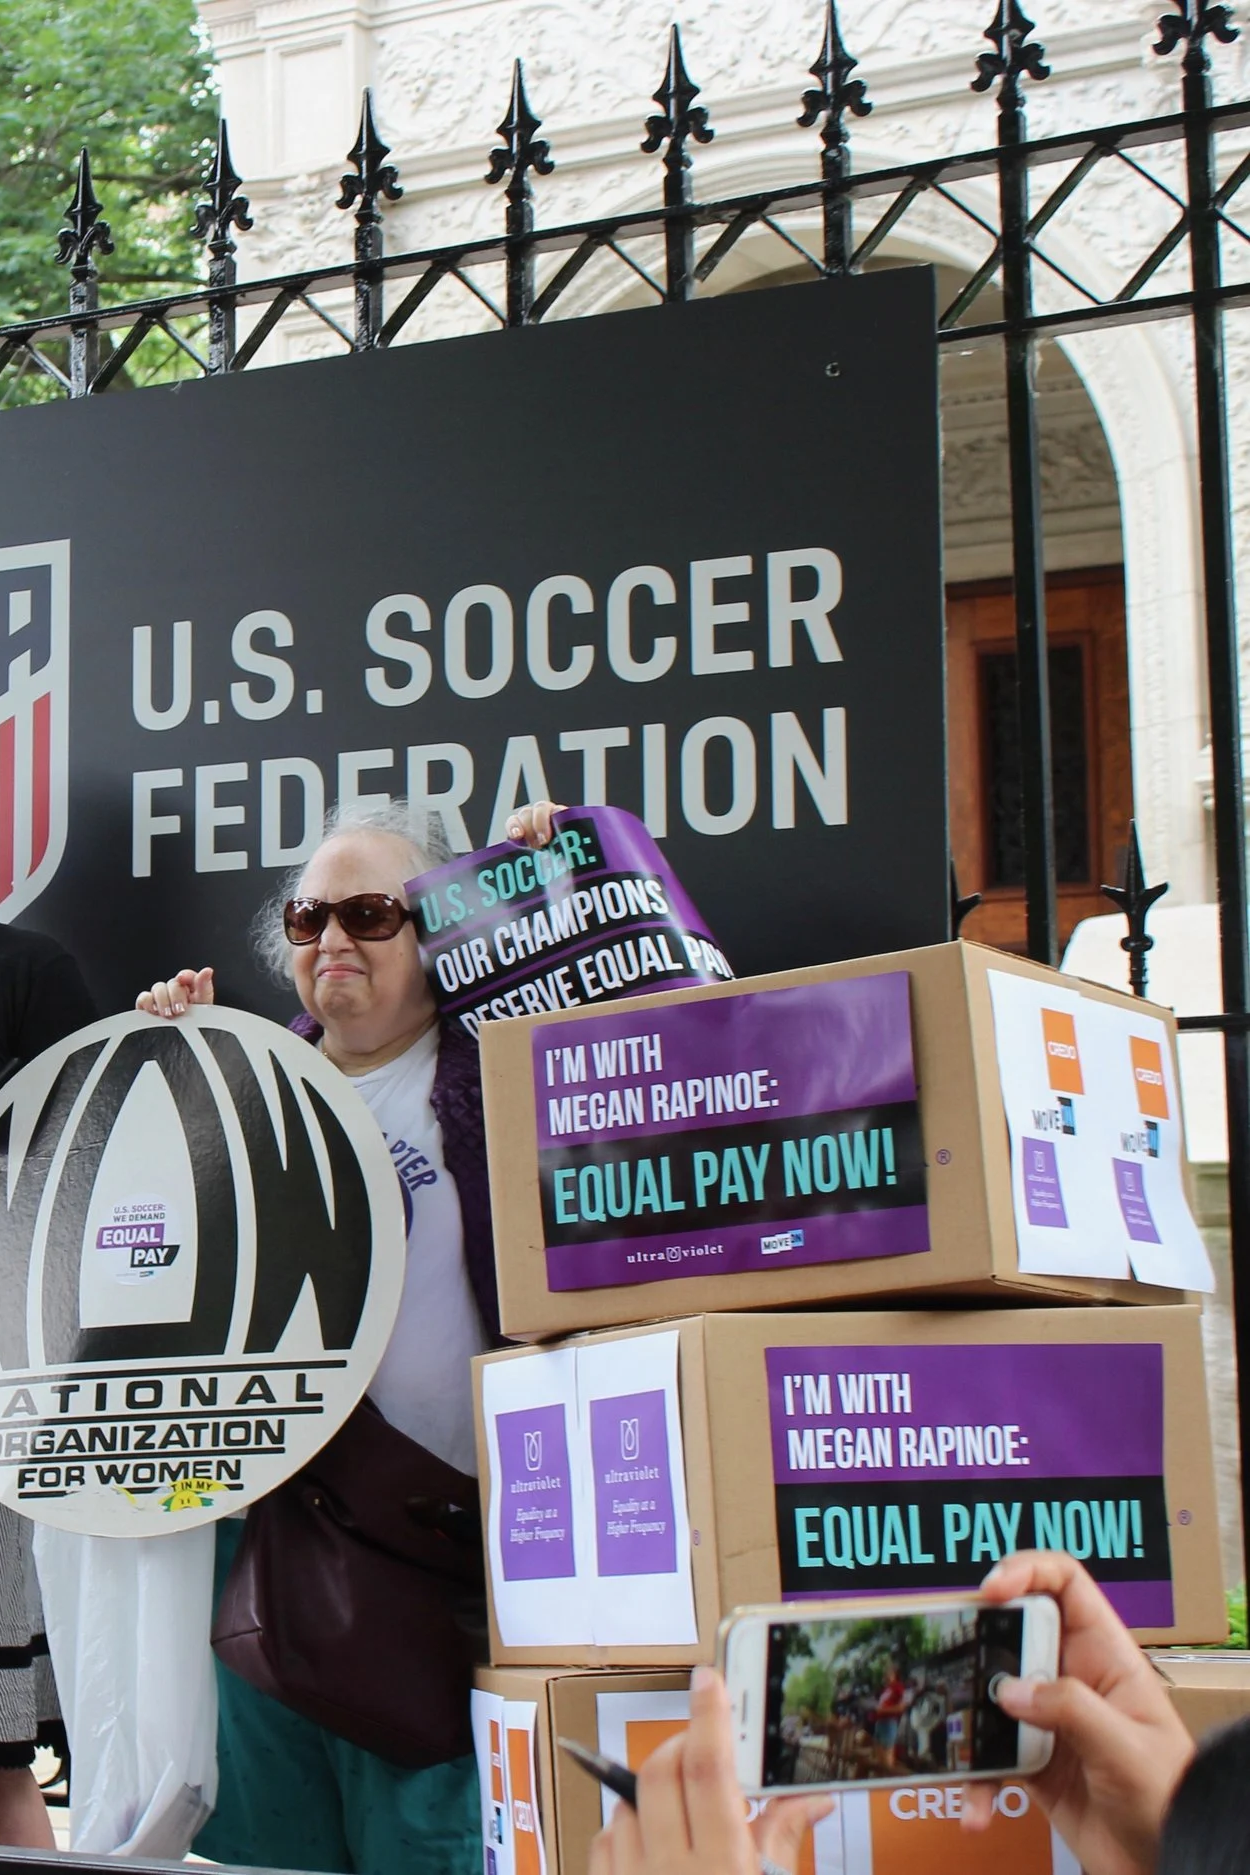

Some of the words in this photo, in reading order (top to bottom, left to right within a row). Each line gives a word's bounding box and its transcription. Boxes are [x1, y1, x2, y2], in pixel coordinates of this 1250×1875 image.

[131, 608, 324, 732] U.S.
[364, 546, 845, 708] SOCCER
[131, 706, 849, 878] FEDERATION
[419, 882, 475, 934] U.S.
[477, 828, 598, 908] SOCCER:
[435, 929, 495, 993] OUR
[493, 877, 671, 968] CHAMPIONS
[575, 934, 683, 998] EQUAL
[591, 1032, 663, 1080] WITH
[548, 1086, 645, 1136] MEGAN
[651, 1069, 779, 1123] RAPINOE:
[553, 1155, 685, 1225] EQUAL
[693, 1142, 770, 1208] PAY
[782, 1126, 899, 1198] NOW!
[113, 1215, 127, 1223] WE
[128, 1212, 166, 1222] DEMAND
[114, 1206, 130, 1214] U.S.
[131, 1203, 166, 1213] SOCCER:
[101, 1227, 161, 1246] EQUAL
[133, 1247, 169, 1265] PAY
[837, 1373, 912, 1414] WITH
[787, 1427, 893, 1470] MEGAN
[899, 1424, 1031, 1468] RAPINOE:
[17, 1465, 85, 1490] FOR
[94, 1458, 242, 1485] WOMEN
[181, 1481, 192, 1490] IN
[196, 1481, 214, 1491] MY
[510, 1476, 562, 1494] ultraviolet
[604, 1465, 660, 1484] ultraviolet
[794, 1505, 935, 1570] EQUAL
[943, 1502, 1023, 1564] PAY
[1033, 1499, 1145, 1560] NOW!
[889, 1785, 1030, 1821] CREO
